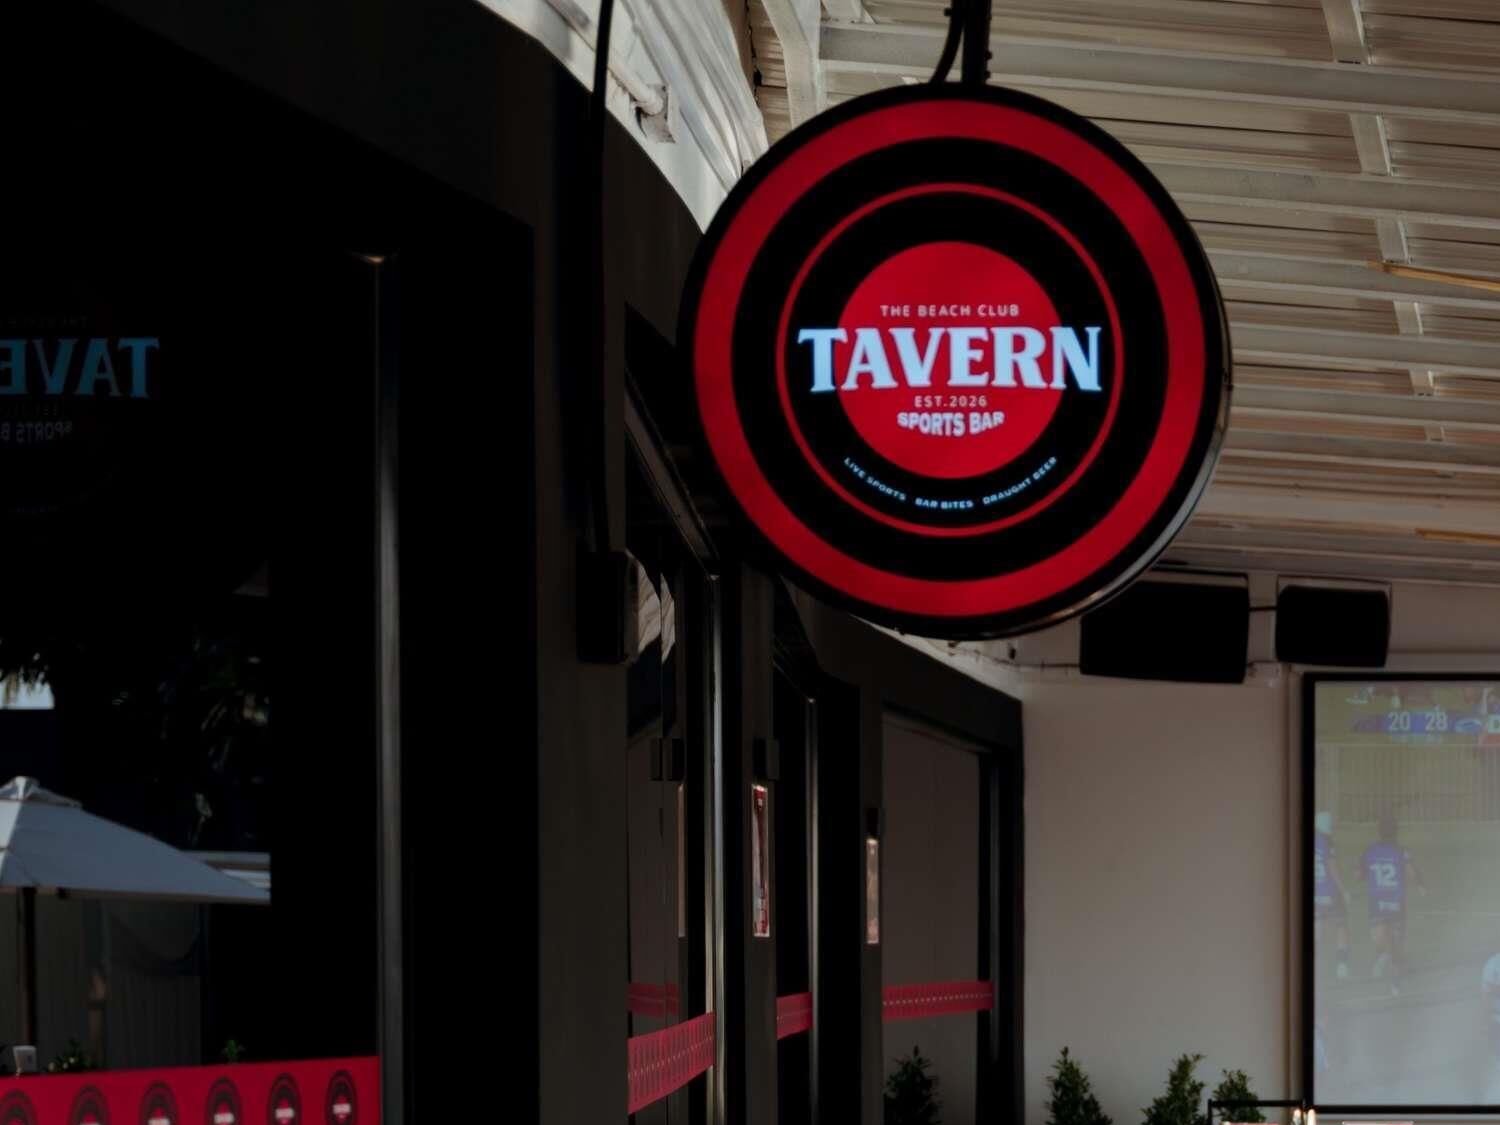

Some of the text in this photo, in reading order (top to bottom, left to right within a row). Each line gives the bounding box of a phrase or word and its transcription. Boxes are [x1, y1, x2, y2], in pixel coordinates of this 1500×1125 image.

[880, 303, 1020, 317] THE BEACH CLUB
[797, 326, 1103, 392] TAVERN
[914, 395, 987, 408] EST.2026
[897, 411, 1005, 437] SPORTS BAR
[844, 456, 1057, 510] LIVE SPORTS BAR BITES DRAUGHT BEER
[1387, 711, 1448, 732] 20 28
[1369, 863, 1399, 887] 12
